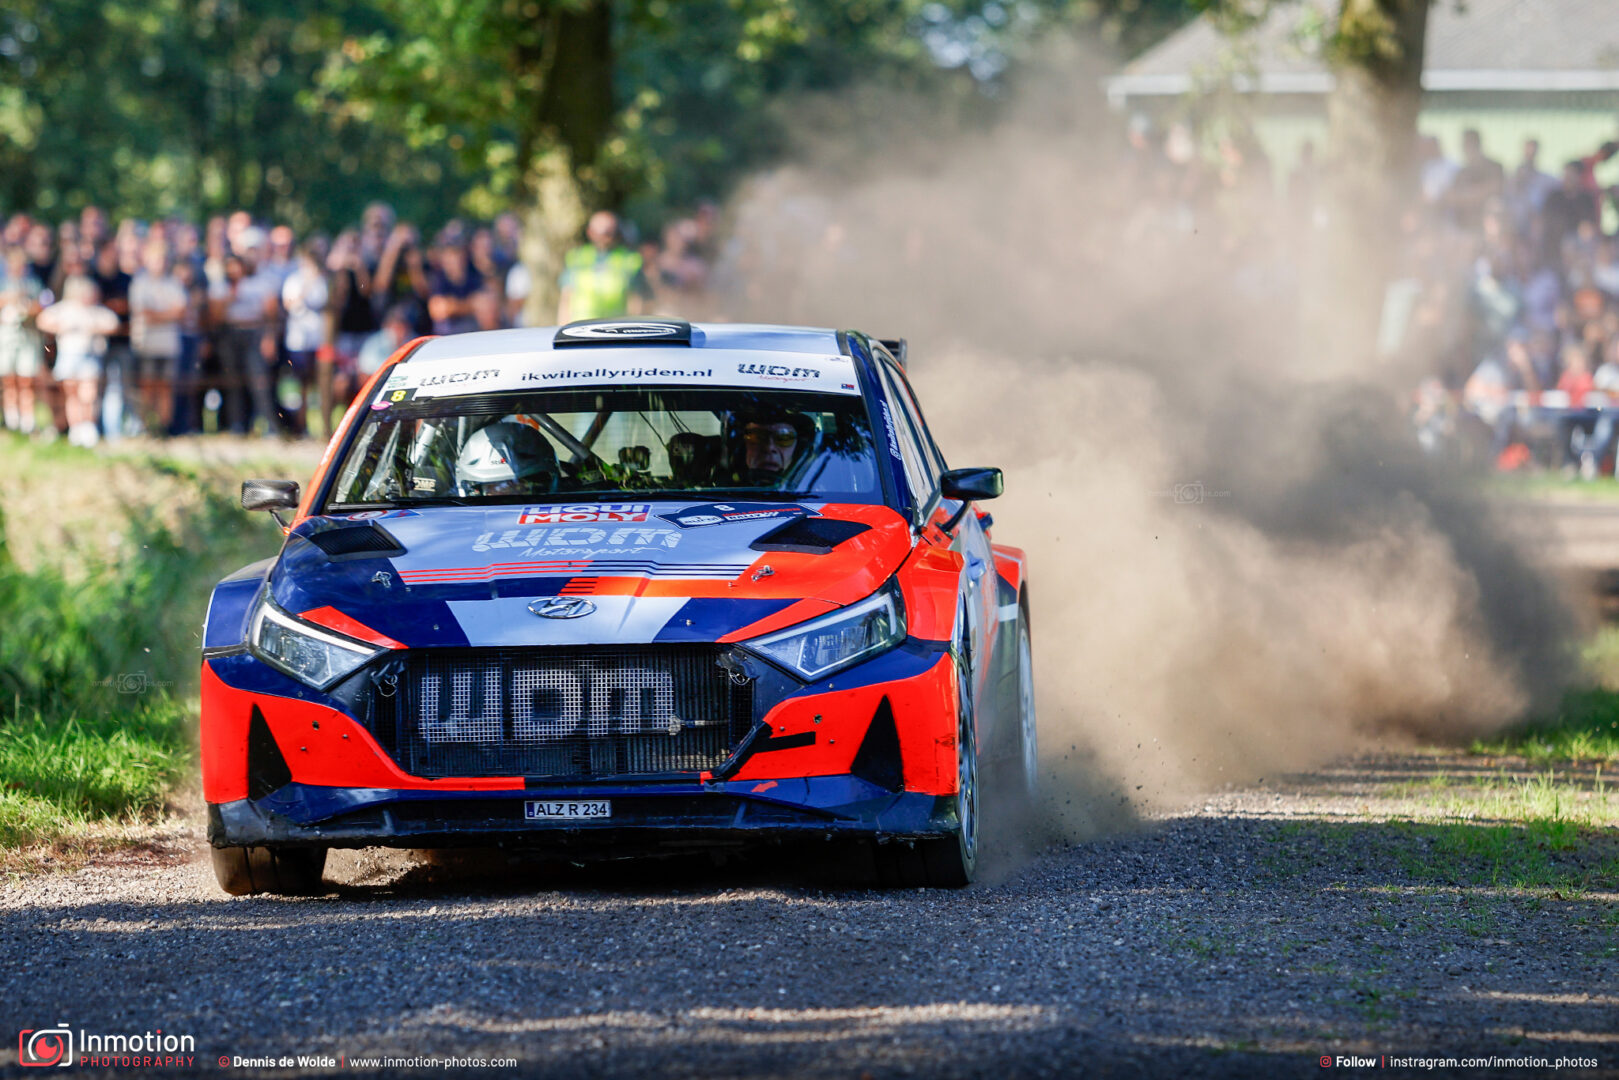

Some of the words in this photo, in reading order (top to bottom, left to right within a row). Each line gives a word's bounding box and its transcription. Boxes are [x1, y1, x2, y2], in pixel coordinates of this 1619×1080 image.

[521, 368, 713, 381] ikwilrallyrijden.nl
[390, 389, 407, 402] 8
[528, 505, 650, 514] LIQUI
[713, 504, 736, 512] 8
[524, 513, 642, 523] MOLY
[518, 547, 666, 560] Motorsport
[536, 803, 565, 816] ALZ
[568, 803, 579, 816] R
[583, 803, 608, 816] 234
